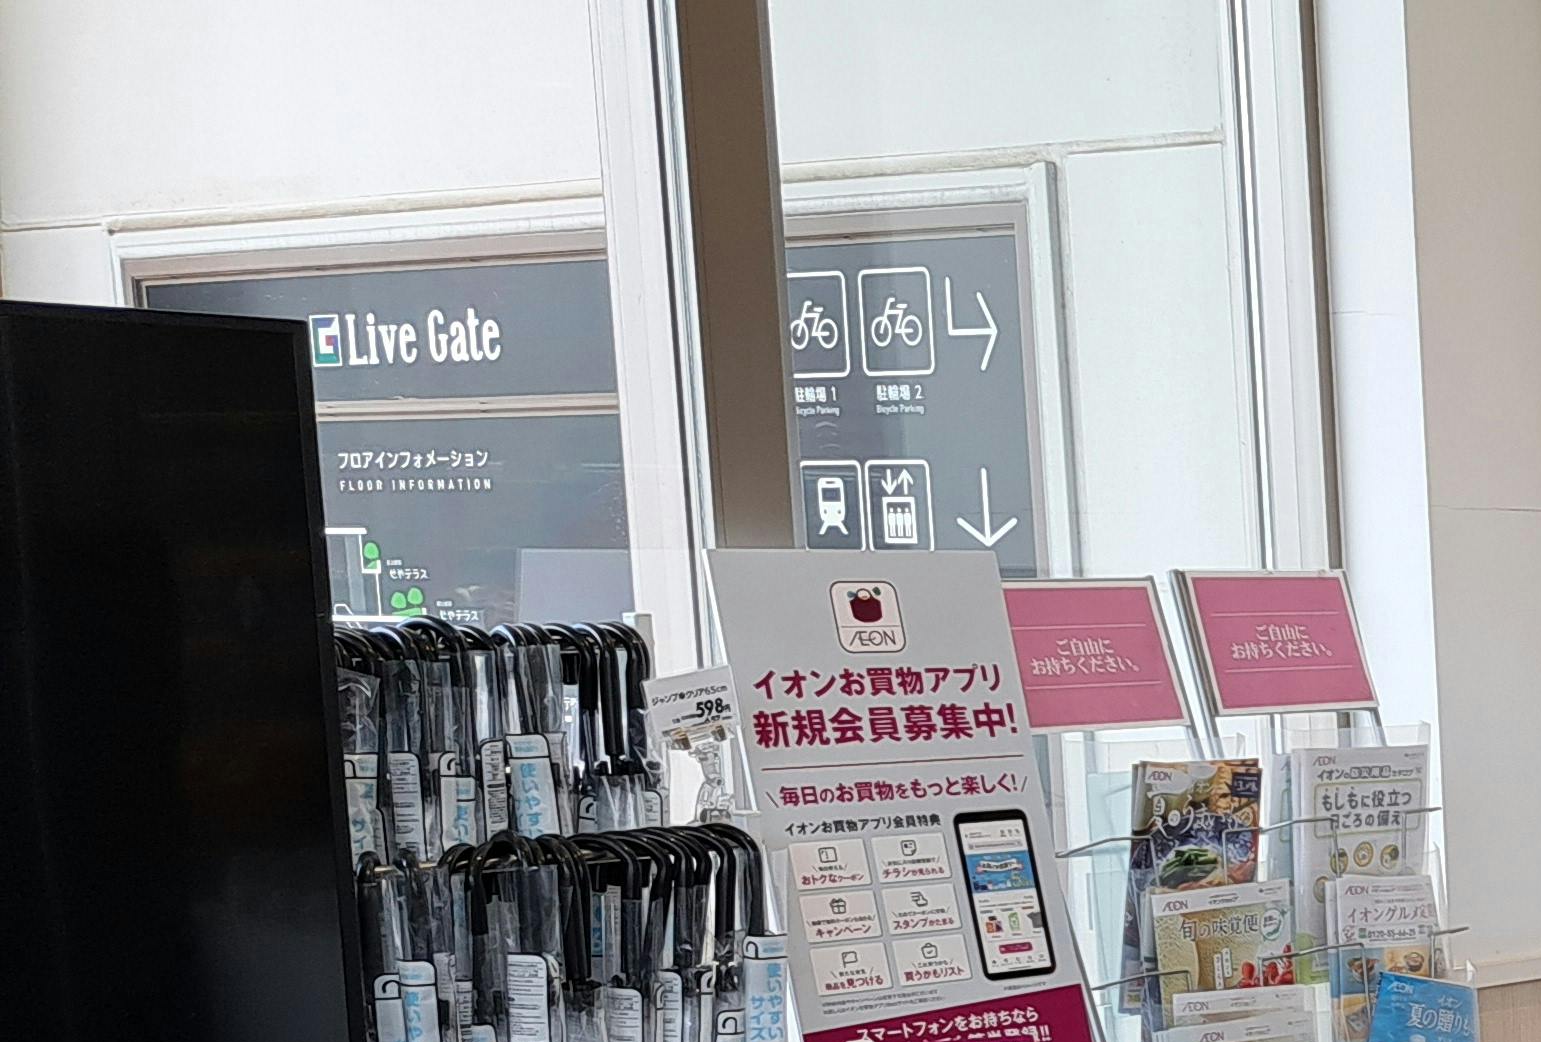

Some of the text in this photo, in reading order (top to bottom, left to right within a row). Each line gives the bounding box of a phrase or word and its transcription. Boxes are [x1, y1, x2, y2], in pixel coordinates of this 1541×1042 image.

[346, 309, 502, 366] Live Gate
[914, 384, 924, 400] 2
[337, 450, 489, 469] フロアインフォメーション
[340, 477, 492, 491] FLOOR INFORMATION
[1231, 641, 1333, 660] お持ちください。
[1031, 657, 1141, 676] お持ちください。
[752, 663, 1001, 700] イオンお買物アプリ
[753, 702, 1018, 749] 新規会員募集中!
[778, 773, 1020, 808] 毎日のお買物をもっと楽しく!
[1321, 790, 1412, 812] もしもに役立つ
[1180, 914, 1259, 943] 旬の味覚便
